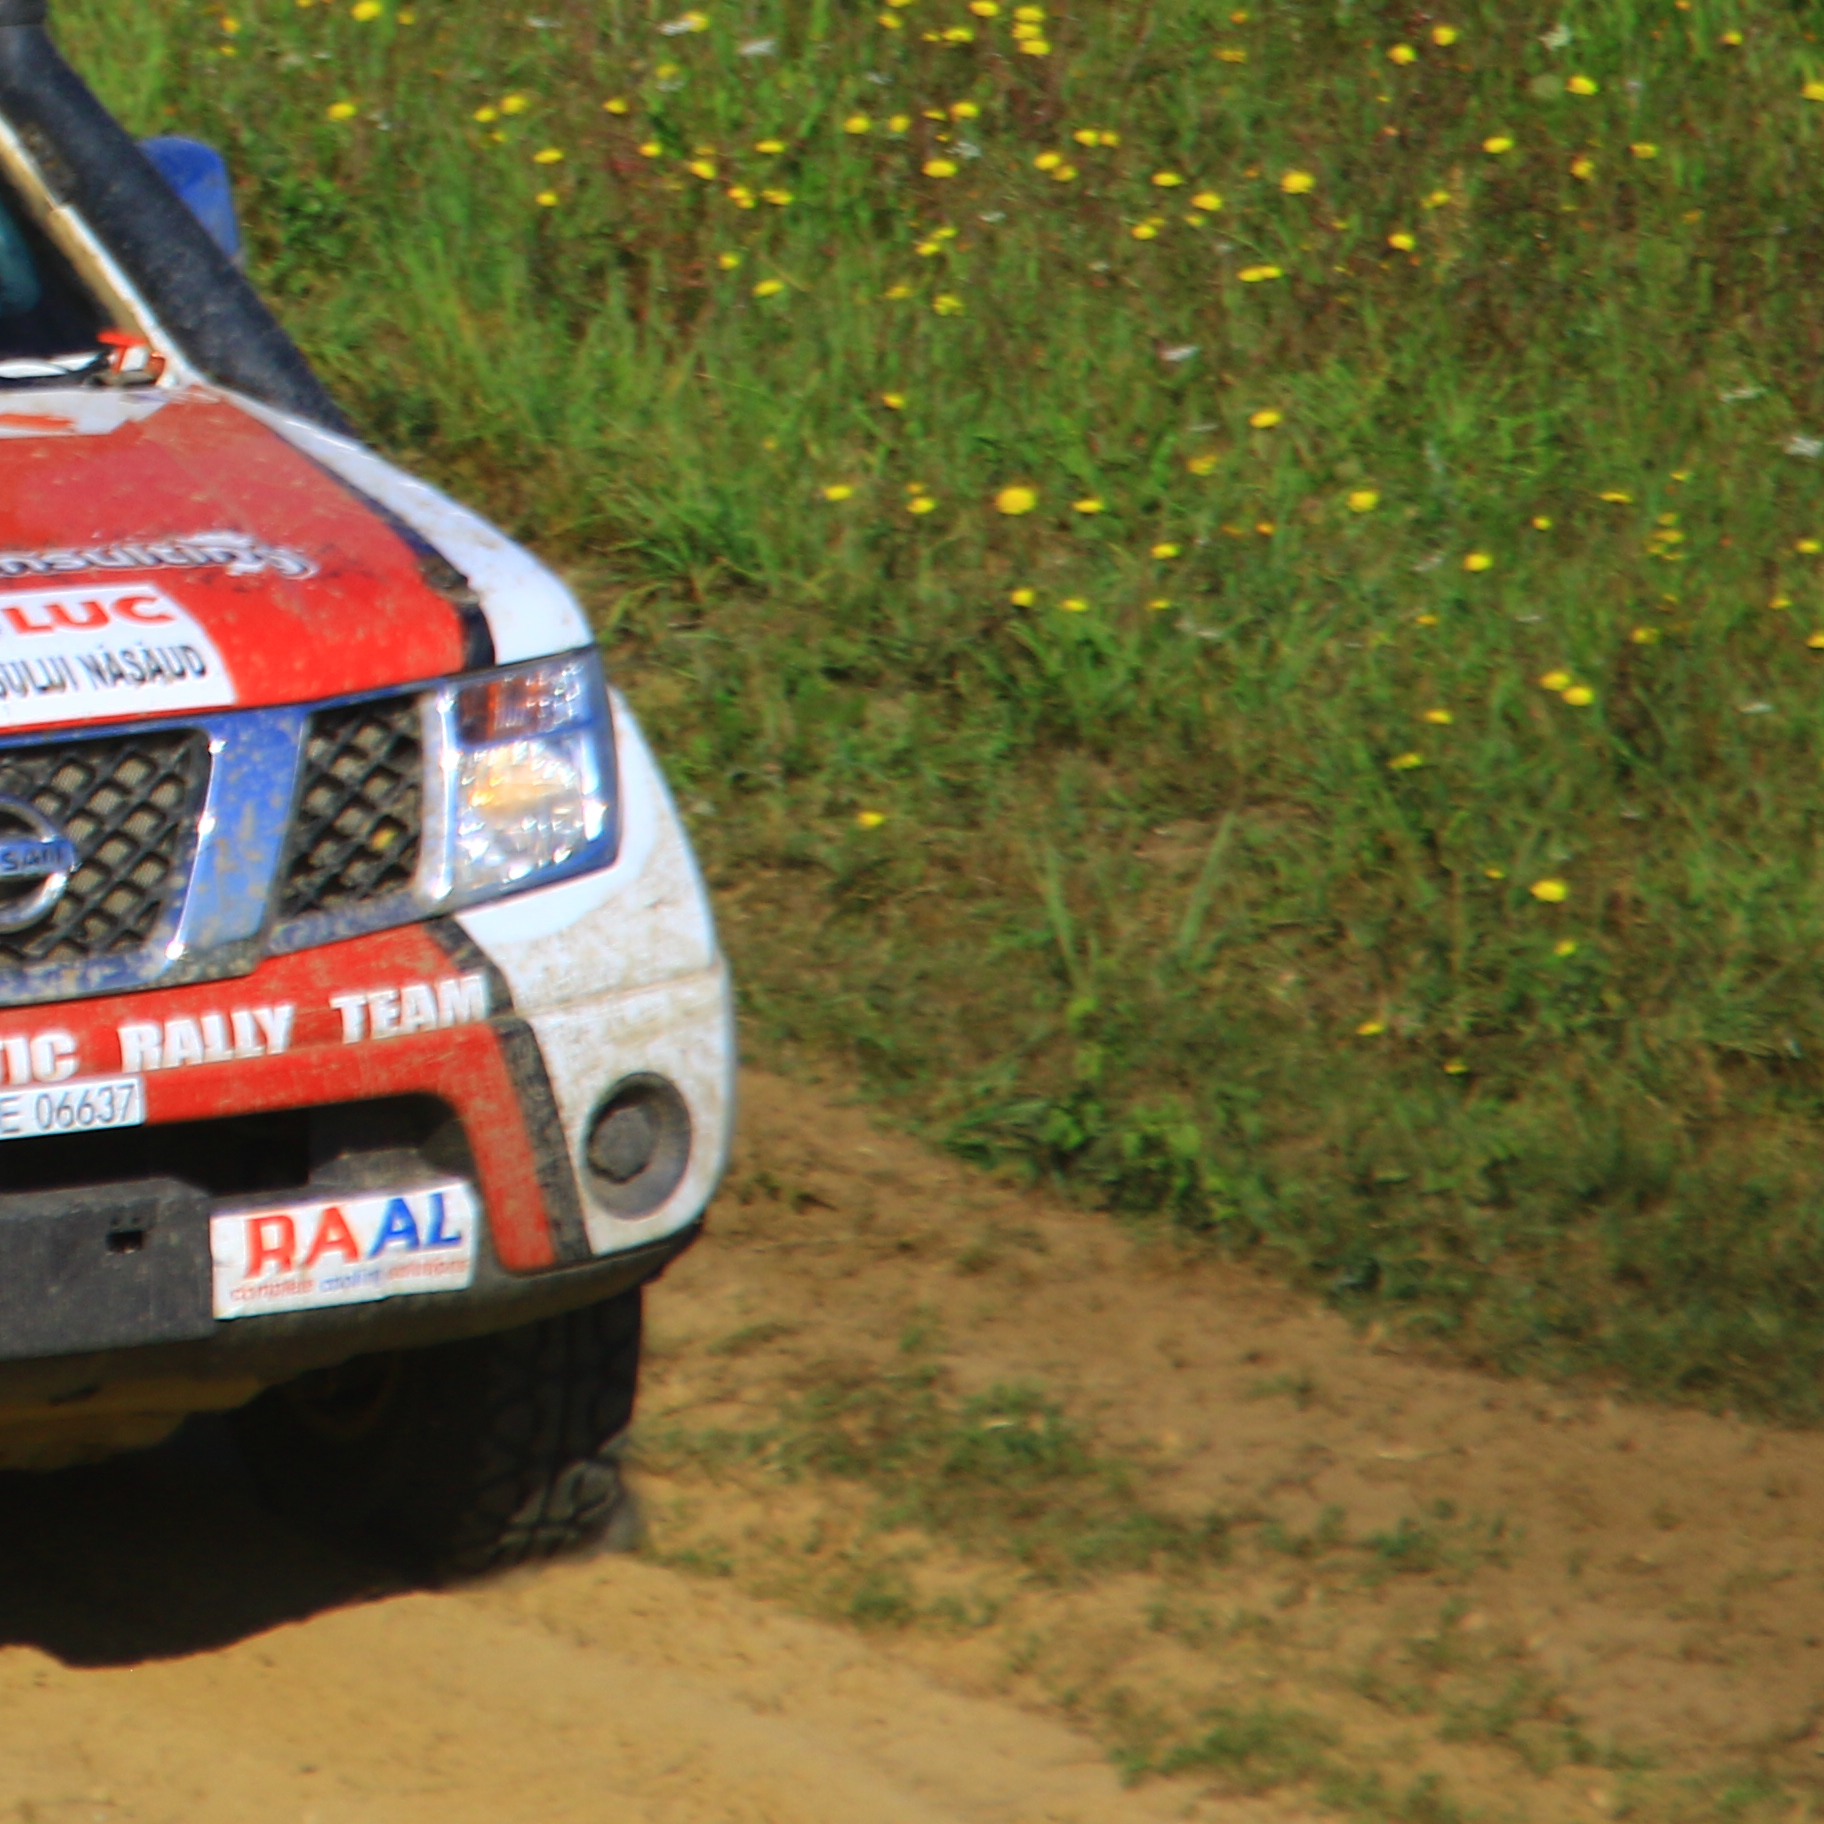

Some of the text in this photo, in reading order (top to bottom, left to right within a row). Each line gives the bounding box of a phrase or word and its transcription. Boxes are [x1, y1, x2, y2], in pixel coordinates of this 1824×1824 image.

[1, 594, 176, 635] LUC
[116, 1004, 294, 1076] RALLY
[329, 973, 488, 1045] TEAM
[34, 1082, 137, 1132] 06637
[245, 1191, 463, 1279] RAAL
